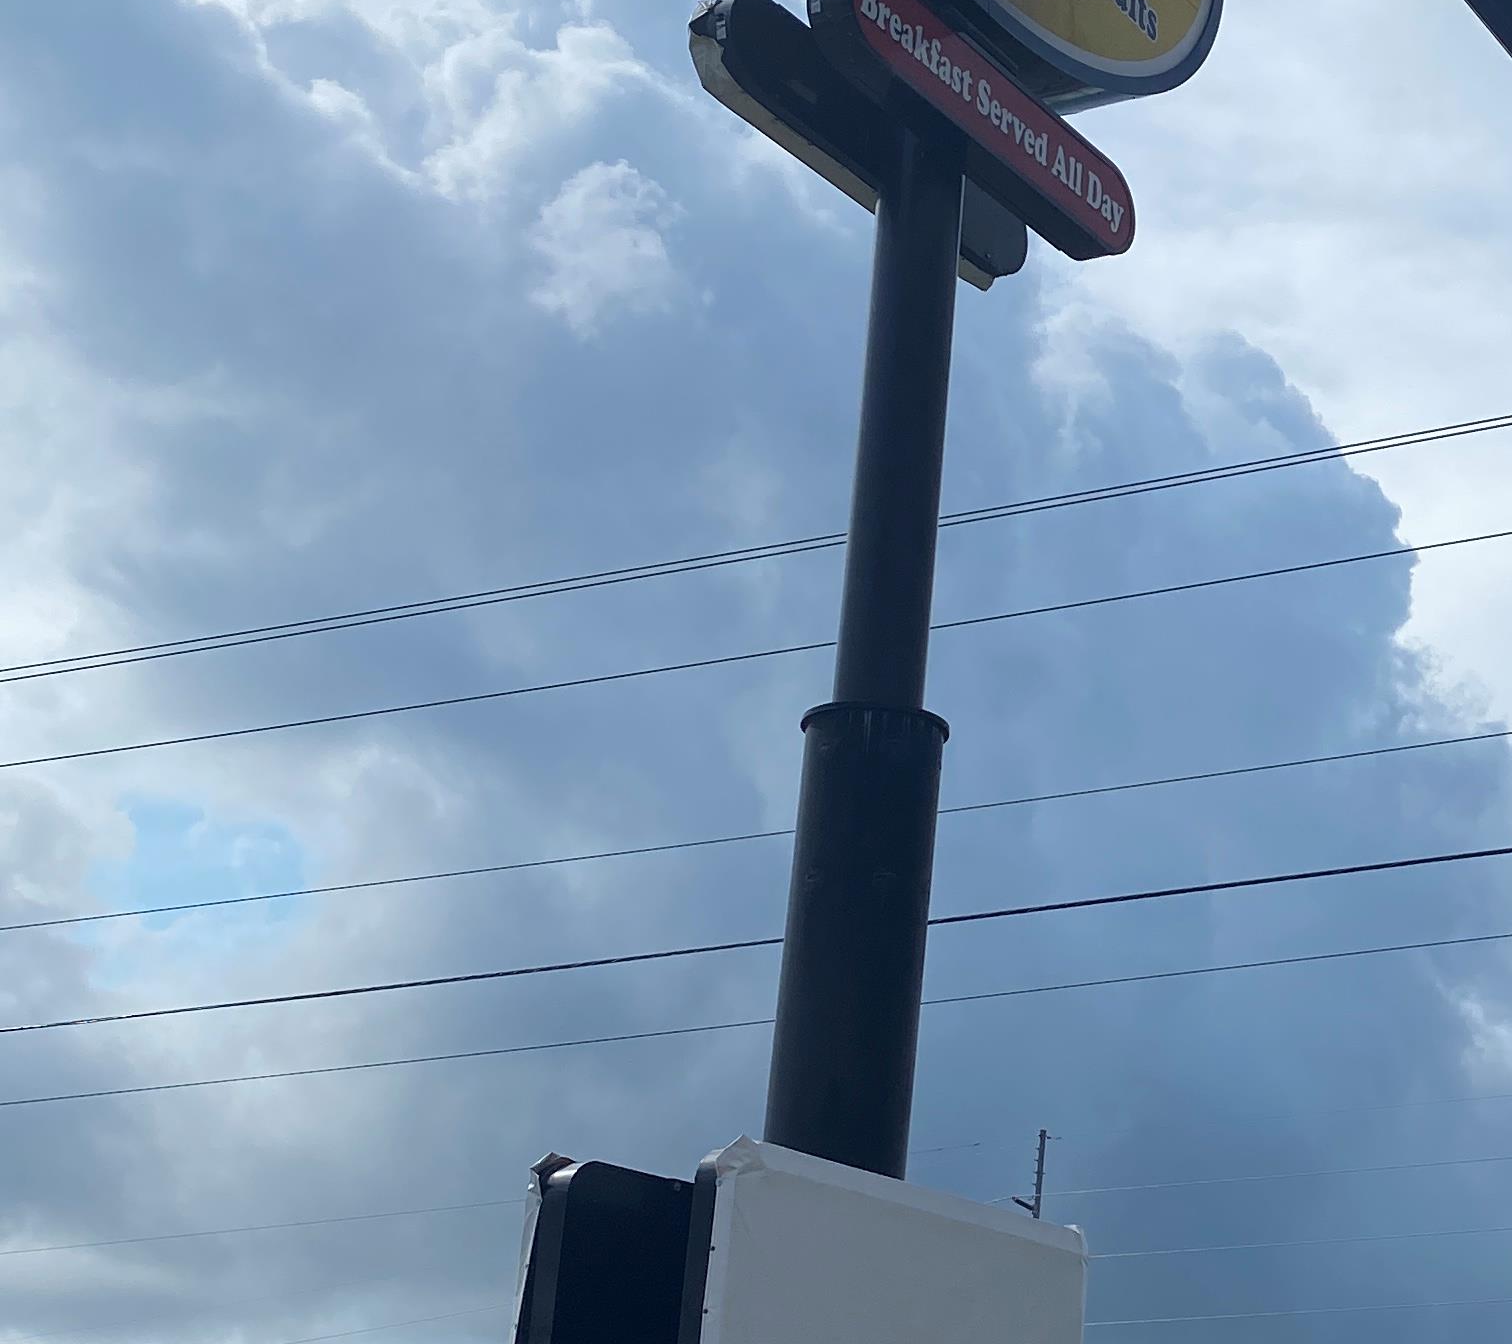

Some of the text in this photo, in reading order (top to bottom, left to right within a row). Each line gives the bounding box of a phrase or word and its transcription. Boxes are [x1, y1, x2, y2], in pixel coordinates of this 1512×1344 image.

[976, 79, 1049, 167] Served
[1051, 144, 1082, 197] All
[1086, 171, 1125, 233] Day
